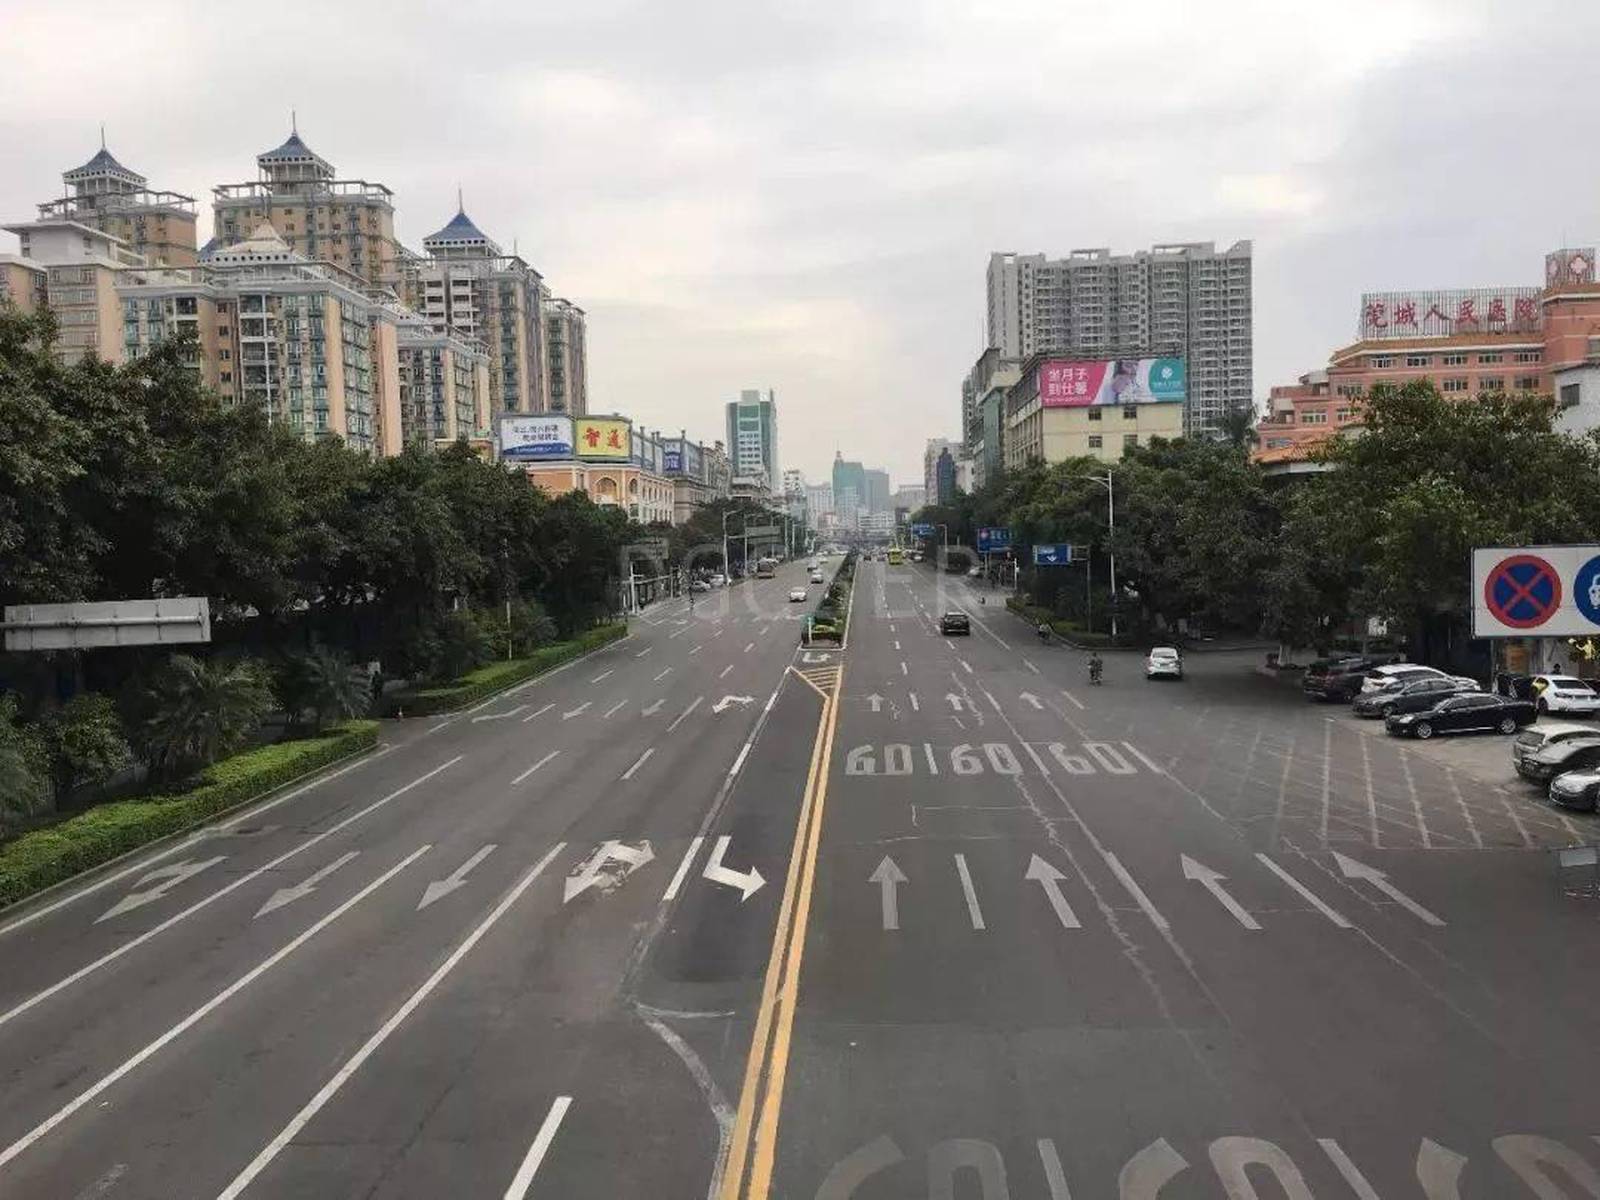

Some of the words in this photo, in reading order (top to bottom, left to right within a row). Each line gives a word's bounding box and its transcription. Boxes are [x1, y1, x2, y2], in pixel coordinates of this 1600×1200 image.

[1365, 298, 1539, 328] 莞城人民医院
[1048, 368, 1088, 381] 坐月子
[845, 743, 913, 776] 60
[950, 743, 1024, 776] 60
[1048, 742, 1138, 776] 60
